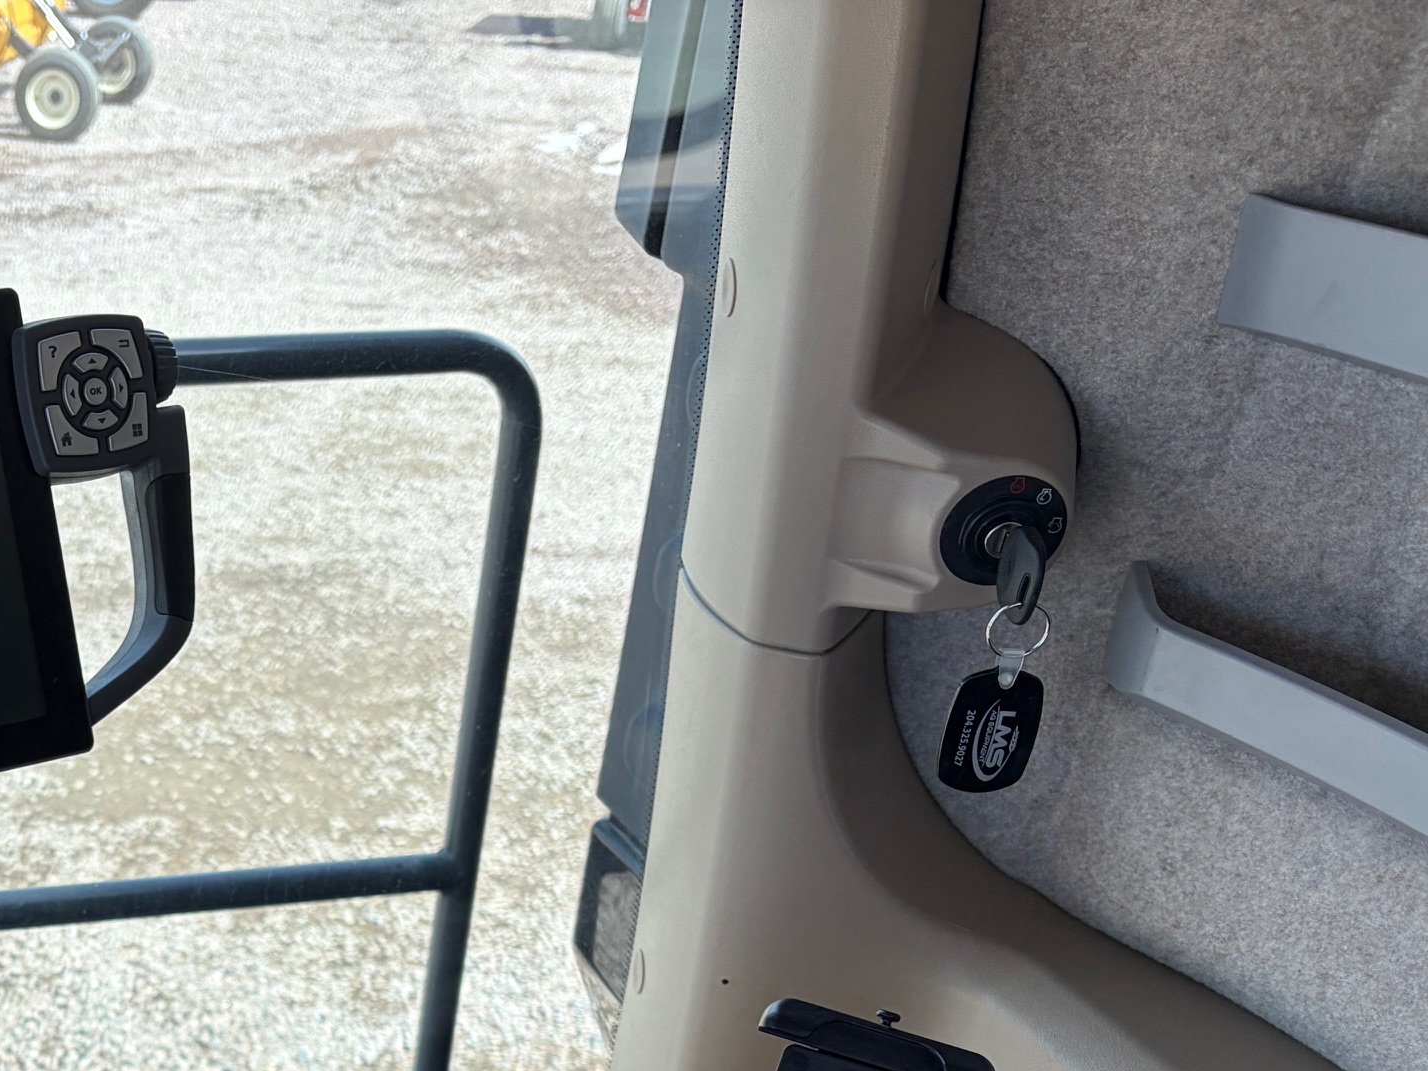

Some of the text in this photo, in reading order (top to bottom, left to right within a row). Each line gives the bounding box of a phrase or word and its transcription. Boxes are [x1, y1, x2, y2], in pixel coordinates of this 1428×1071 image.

[89, 387, 103, 396] OK
[953, 709, 977, 767] 204.325.9027
[978, 709, 998, 763] AG EQUIPMENT
[985, 710, 1017, 769] LMS
